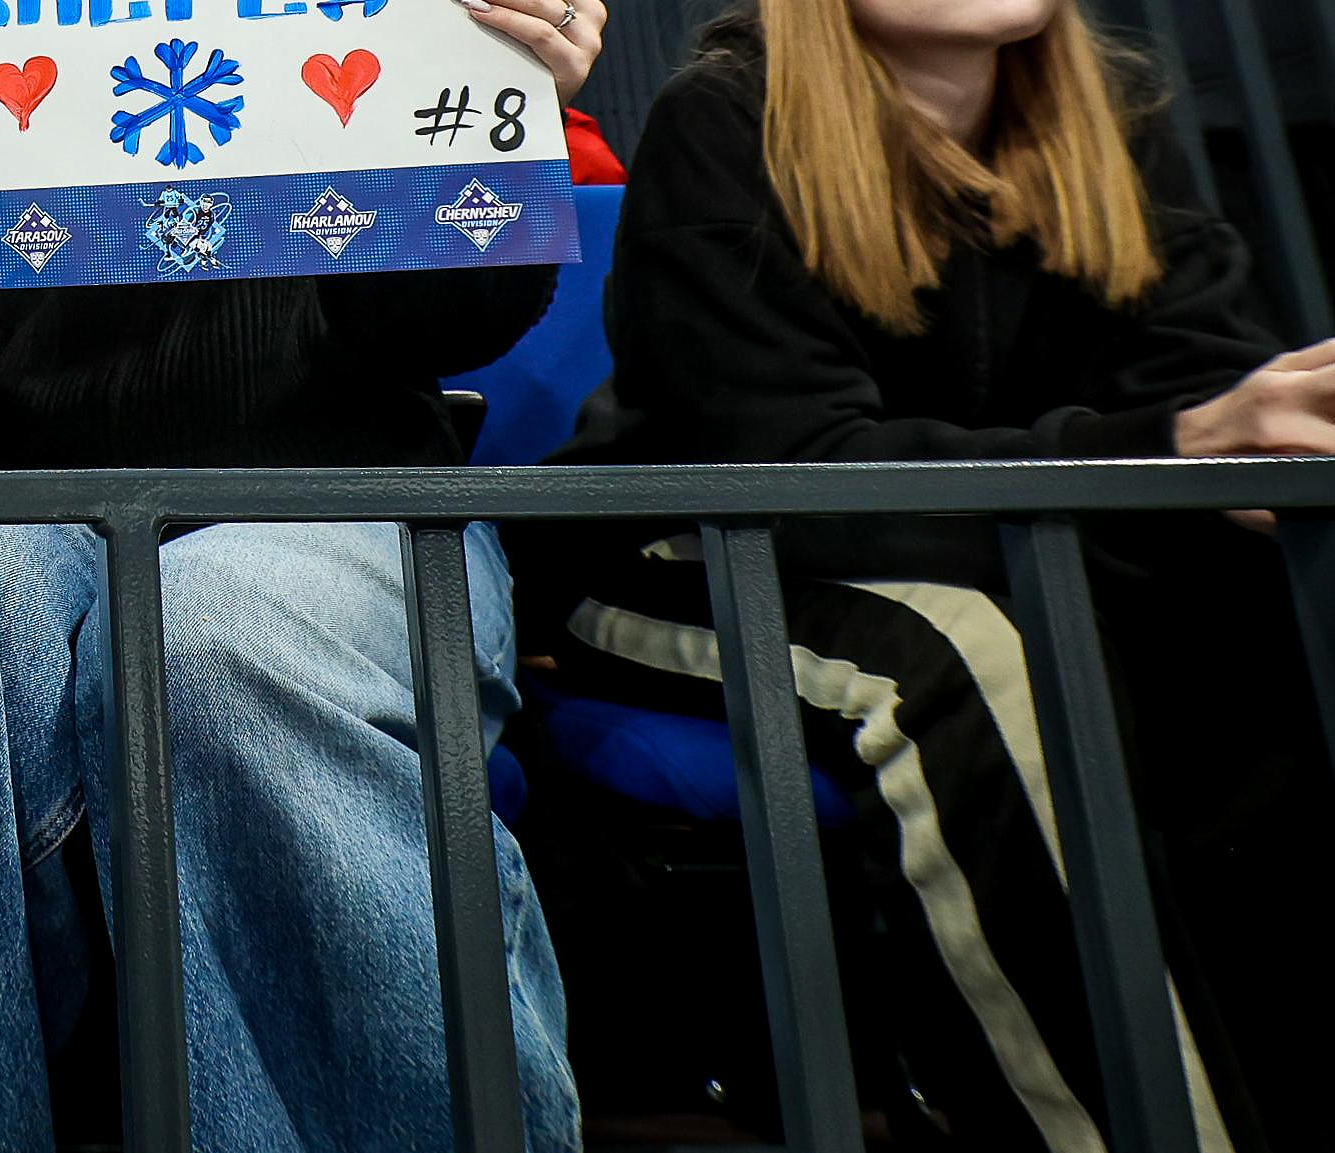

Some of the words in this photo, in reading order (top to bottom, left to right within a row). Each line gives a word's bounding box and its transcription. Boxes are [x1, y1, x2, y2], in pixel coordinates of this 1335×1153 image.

[437, 206, 519, 222] CHERNYSHEV
[293, 212, 373, 230] KHARLAMOV
[461, 219, 498, 228] DIVISION
[9, 229, 64, 244] TARASOV
[315, 226, 352, 236] DIVISION
[19, 242, 55, 251] DIVISION
